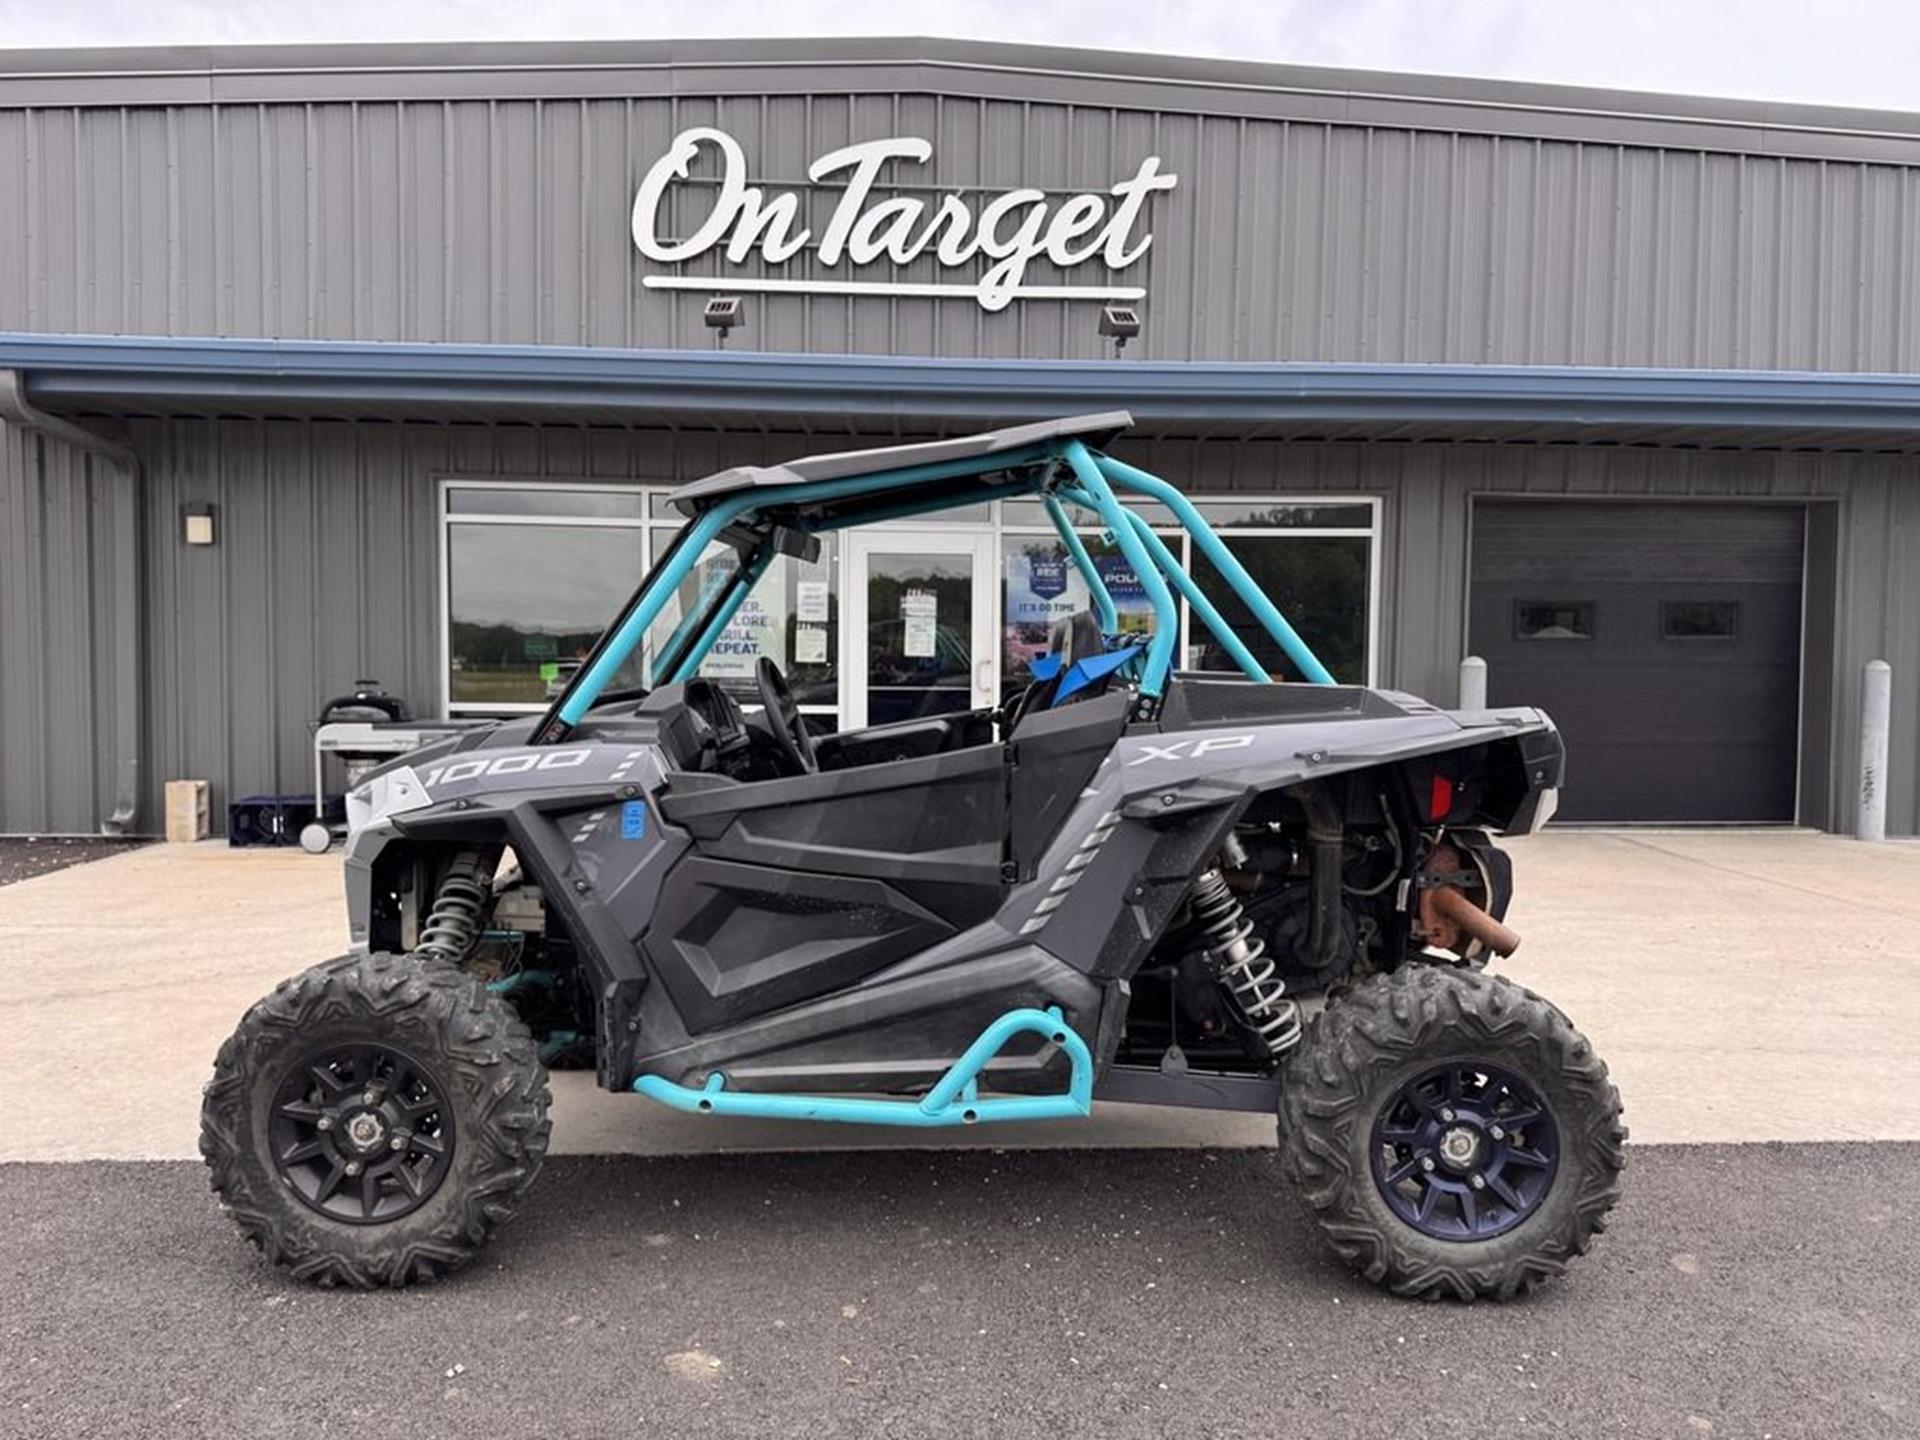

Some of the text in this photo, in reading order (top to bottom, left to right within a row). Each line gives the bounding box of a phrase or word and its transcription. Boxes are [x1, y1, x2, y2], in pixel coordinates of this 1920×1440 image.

[631, 127, 1178, 311] On Target
[425, 749, 592, 788] 1000
[1126, 735, 1256, 766] XP
